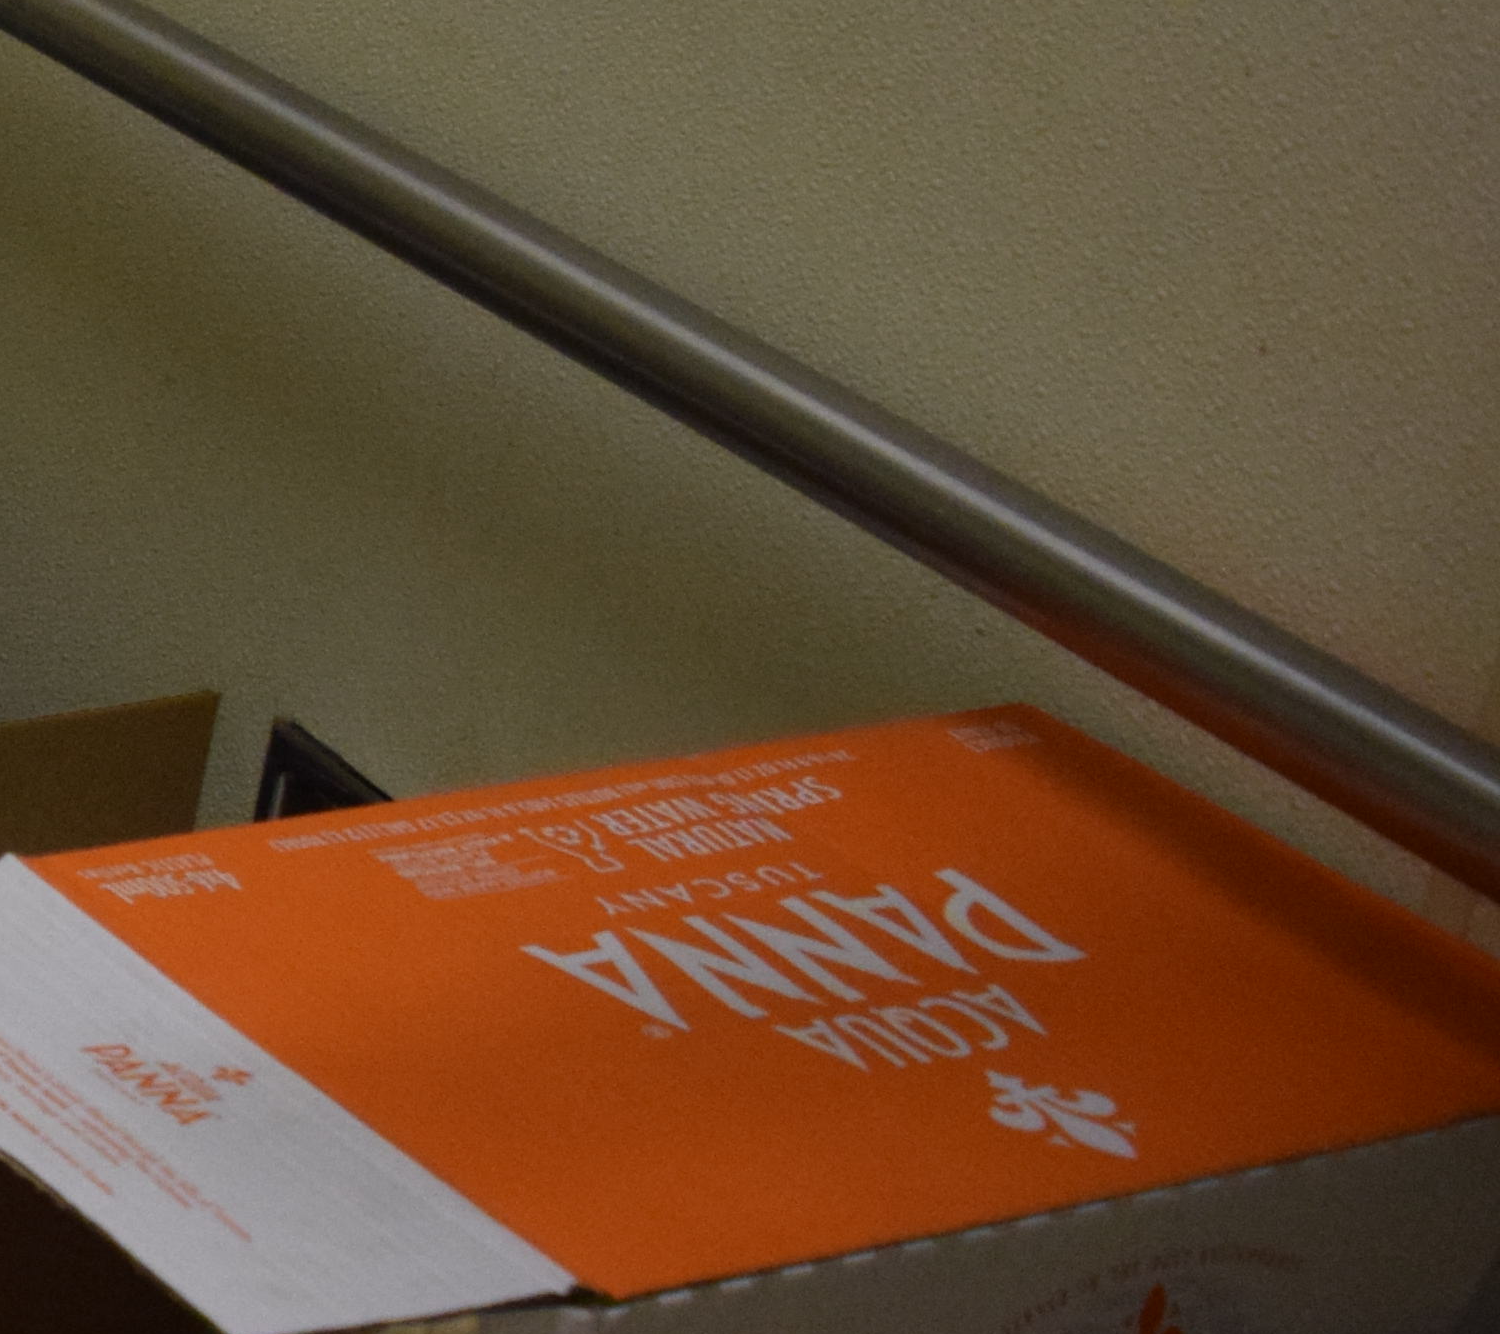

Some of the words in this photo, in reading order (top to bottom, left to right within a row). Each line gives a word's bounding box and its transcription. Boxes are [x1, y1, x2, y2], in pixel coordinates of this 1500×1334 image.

[595, 797, 722, 839] WATER
[709, 774, 845, 818] SPRING
[624, 816, 794, 864] NATURAL
[594, 860, 826, 918] TUSCANY
[518, 866, 1089, 1033] PANNA
[774, 981, 1050, 1074] ACQUA
